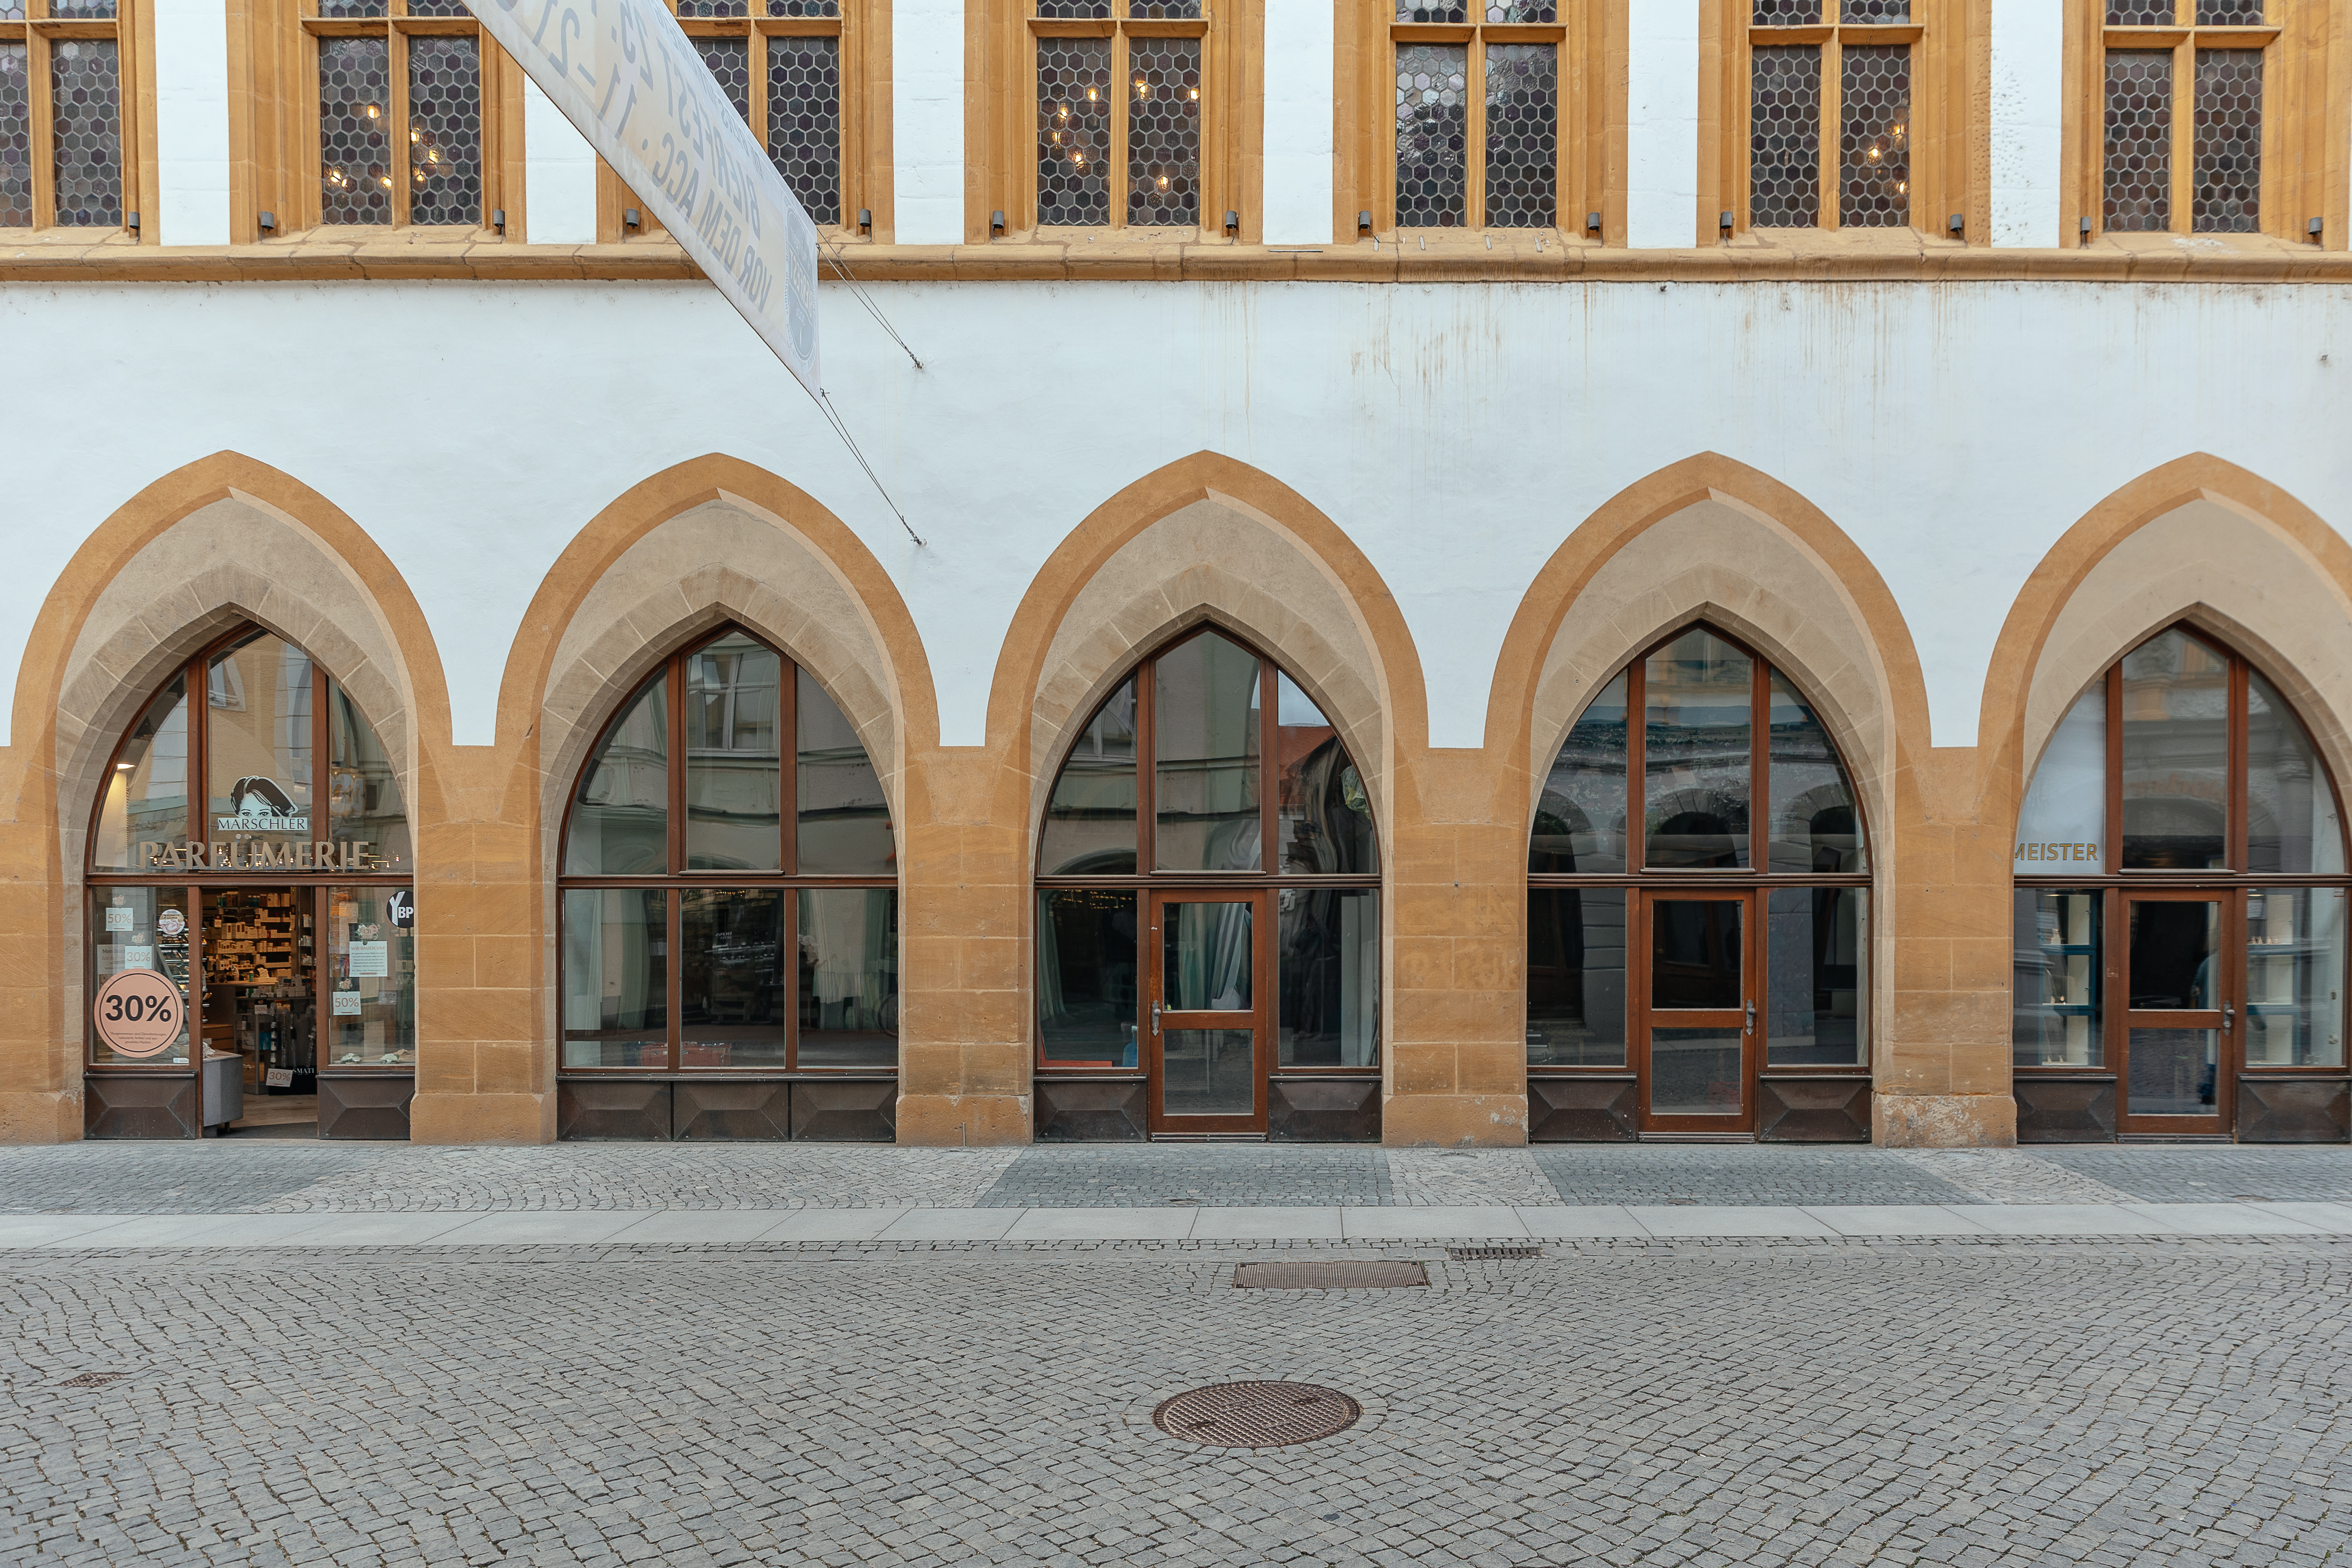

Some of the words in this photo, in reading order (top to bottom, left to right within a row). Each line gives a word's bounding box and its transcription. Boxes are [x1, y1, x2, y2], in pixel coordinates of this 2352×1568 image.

[218, 818, 306, 830] MARSCHLER
[139, 833, 370, 870] PARFÜMERIE
[2015, 843, 2098, 860] MEISTER
[107, 913, 131, 924] 50%
[126, 952, 150, 962] 30%
[335, 997, 359, 1008] 50%
[105, 995, 172, 1022] 30%
[268, 1072, 291, 1081] 30%
